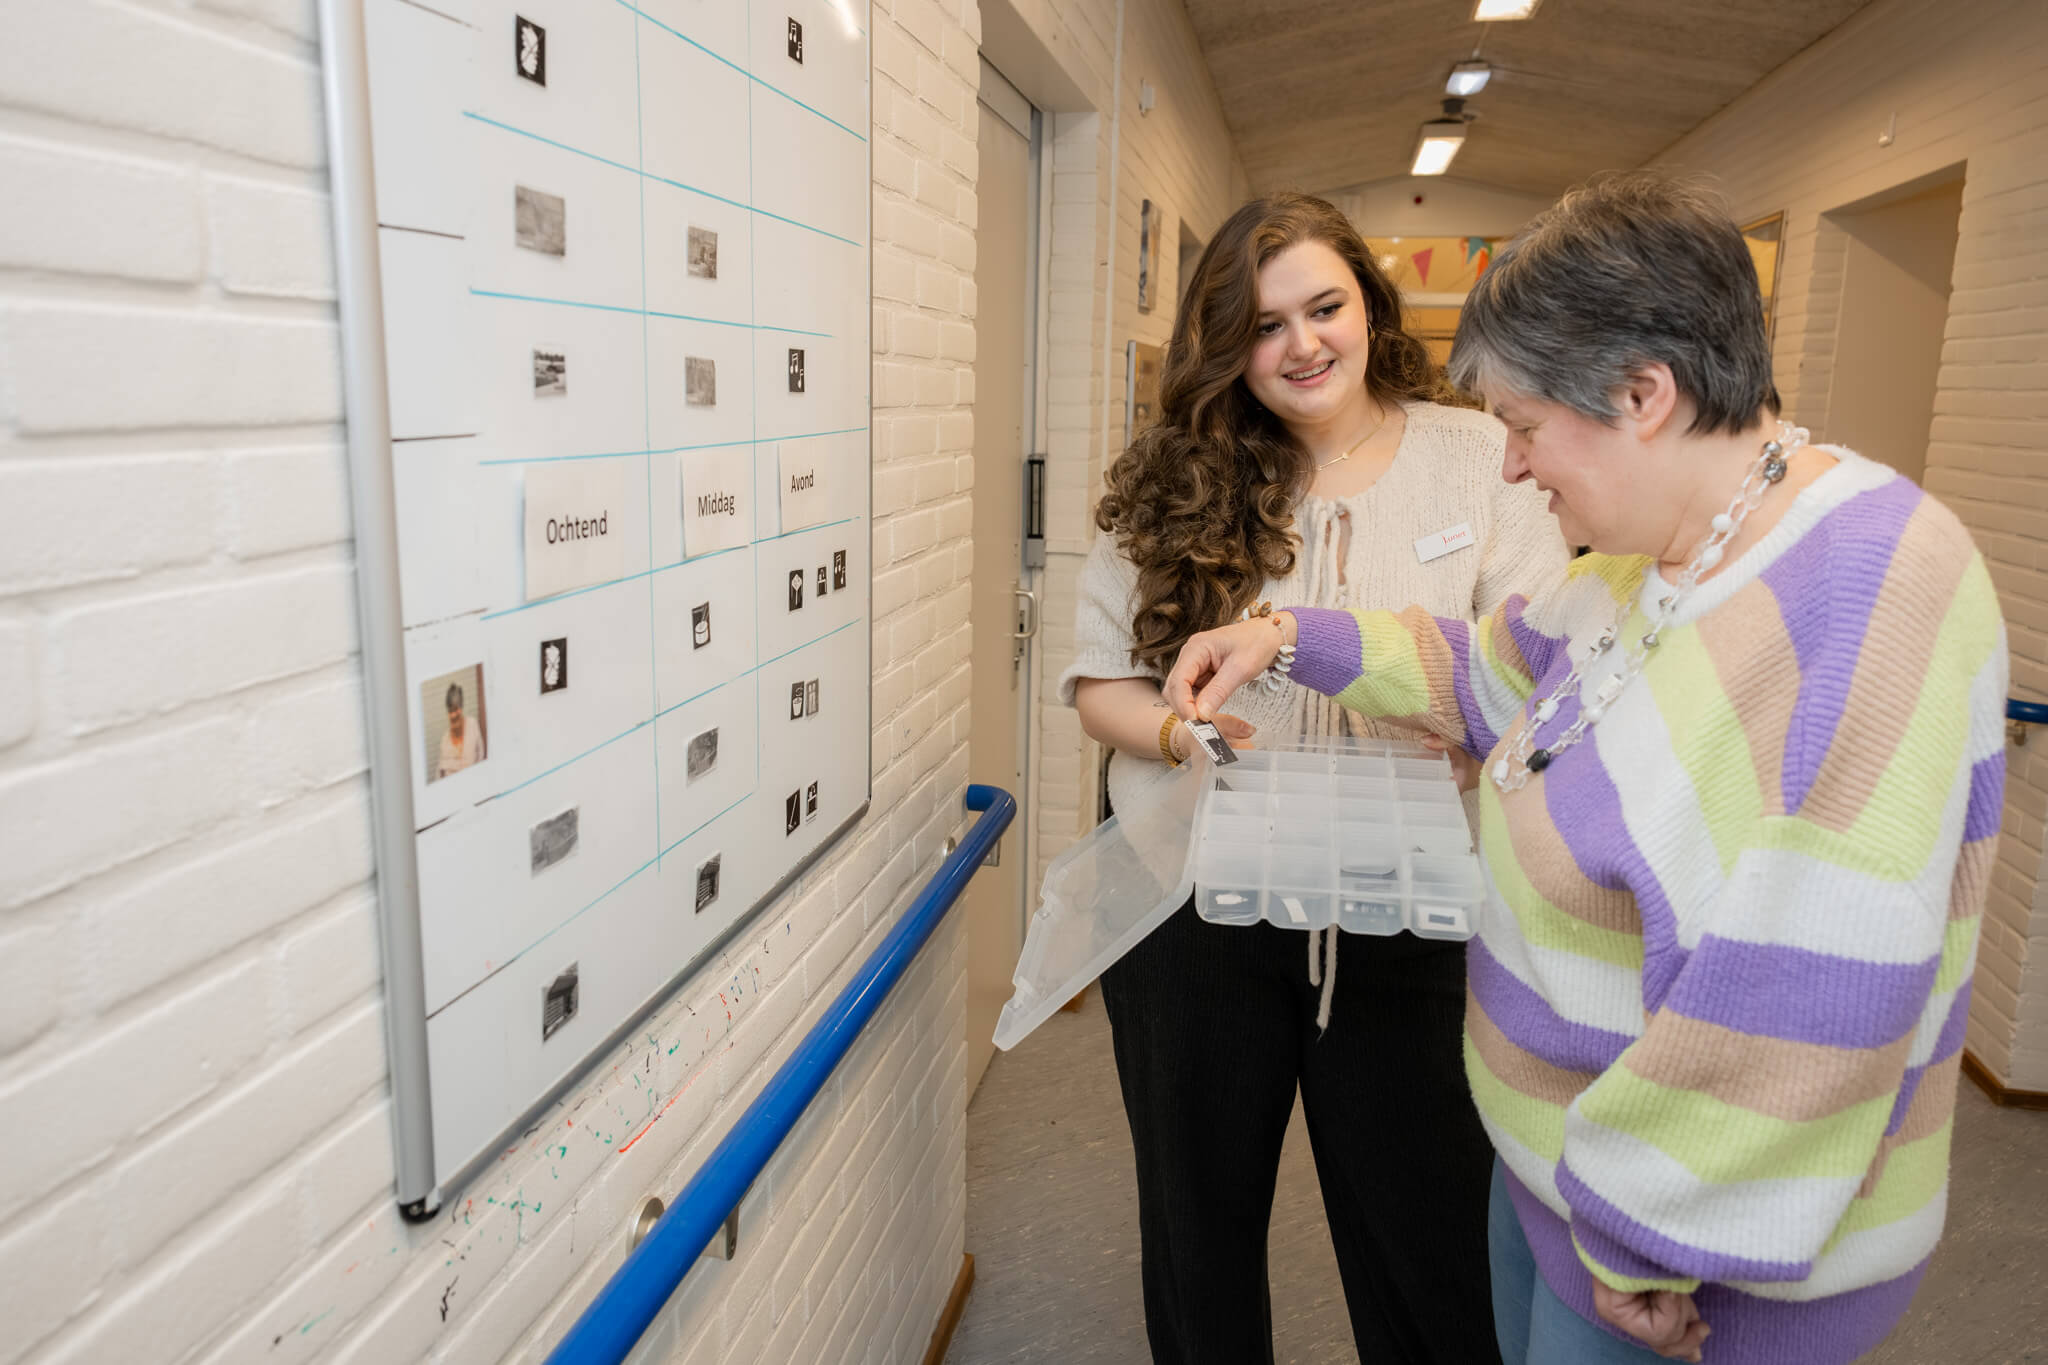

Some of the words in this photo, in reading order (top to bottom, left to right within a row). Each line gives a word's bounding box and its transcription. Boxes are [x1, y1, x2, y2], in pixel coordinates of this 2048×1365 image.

[790, 469, 815, 493] Avond
[697, 493, 736, 518] Middag
[546, 510, 609, 545] Ochtend
